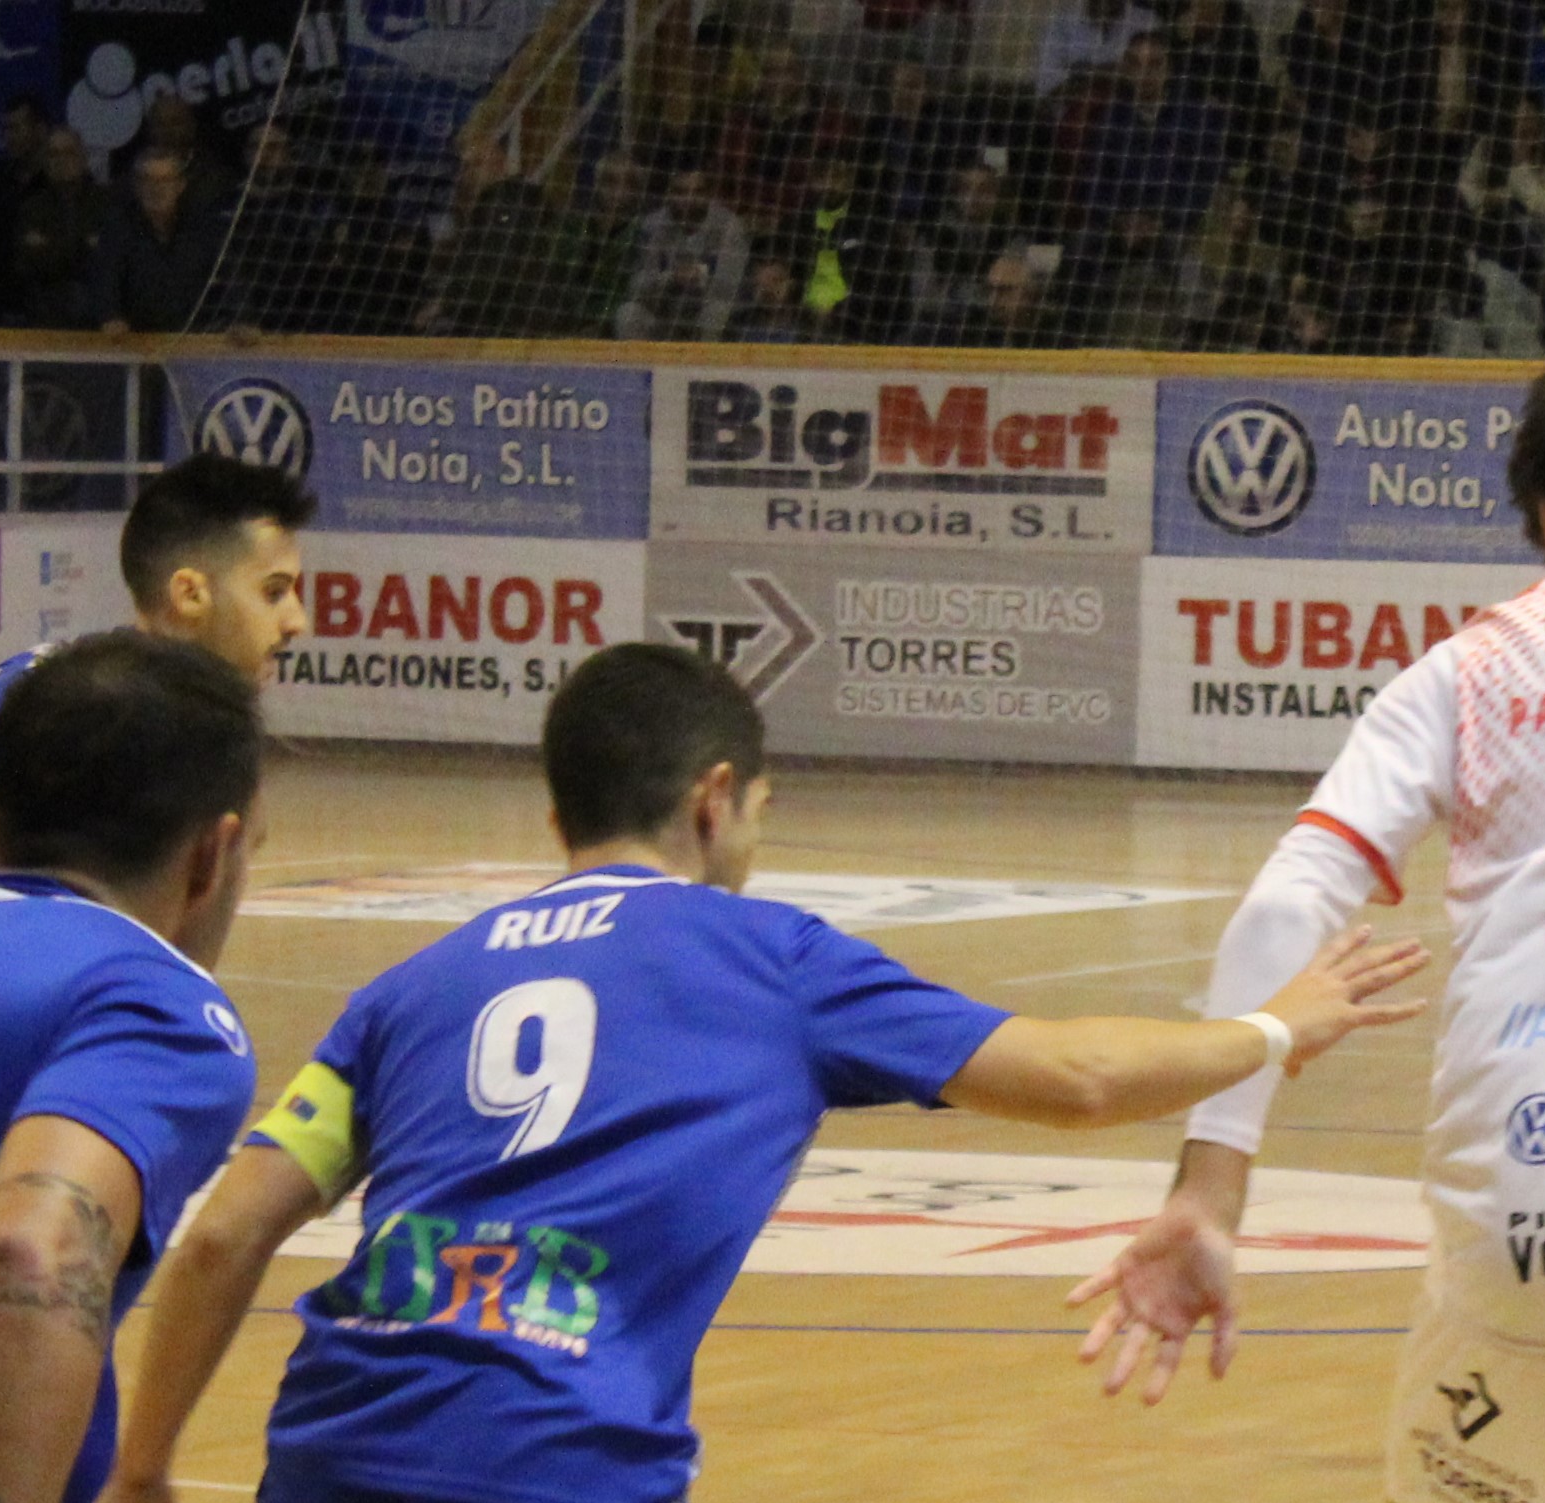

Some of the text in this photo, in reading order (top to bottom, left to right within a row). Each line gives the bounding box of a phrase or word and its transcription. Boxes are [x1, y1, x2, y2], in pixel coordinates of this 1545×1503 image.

[330, 382, 610, 431] Autos Patiño
[1335, 403, 1468, 450] Autos
[686, 380, 1119, 490] BigMat
[361, 438, 576, 491] Noia, S.L.
[1369, 461, 1497, 518] Noia,
[766, 498, 1114, 543] Rianoia, S.L.
[296, 572, 604, 647] BANOR
[837, 581, 1101, 631] INDUSTRIAS
[840, 636, 1017, 677] TORRES
[1178, 598, 1465, 671] TUBAN
[273, 652, 511, 698] TALACIONES,
[1192, 681, 1378, 719] INSTALAC
[840, 685, 1108, 723] SISTEMAS DE PVC
[484, 892, 626, 951] RUIZ
[466, 977, 598, 1162] 9
